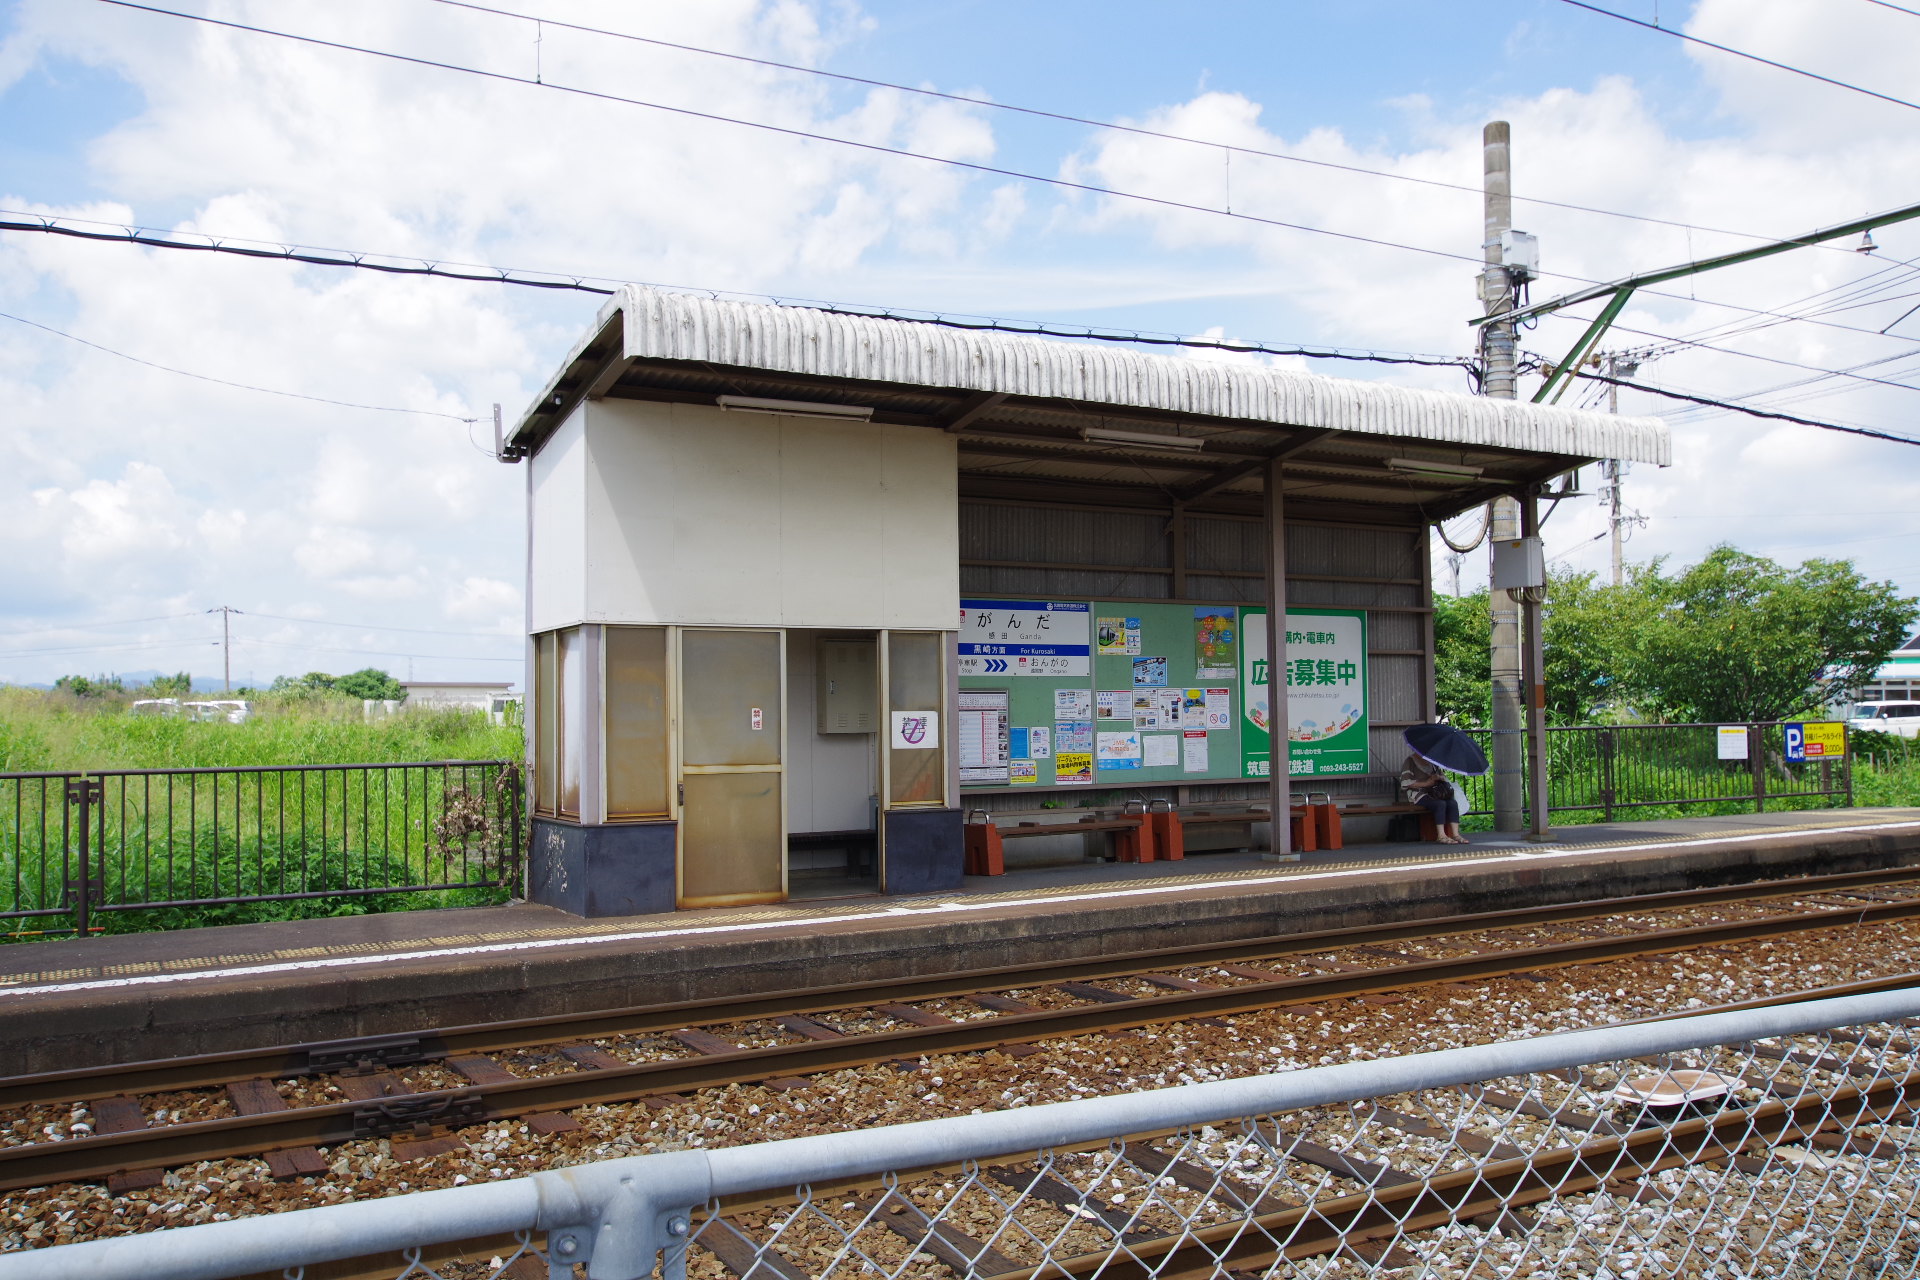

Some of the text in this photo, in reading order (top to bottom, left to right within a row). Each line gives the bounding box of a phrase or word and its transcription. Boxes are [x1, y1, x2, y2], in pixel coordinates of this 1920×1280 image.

[977, 612, 1051, 630] がんだ
[988, 632, 1008, 640] 感田
[973, 645, 1007, 655] 黒崎方面
[1030, 657, 1069, 668] おんがの
[1787, 729, 1801, 757] P
[1247, 759, 1314, 776] 筑豊鉄道
